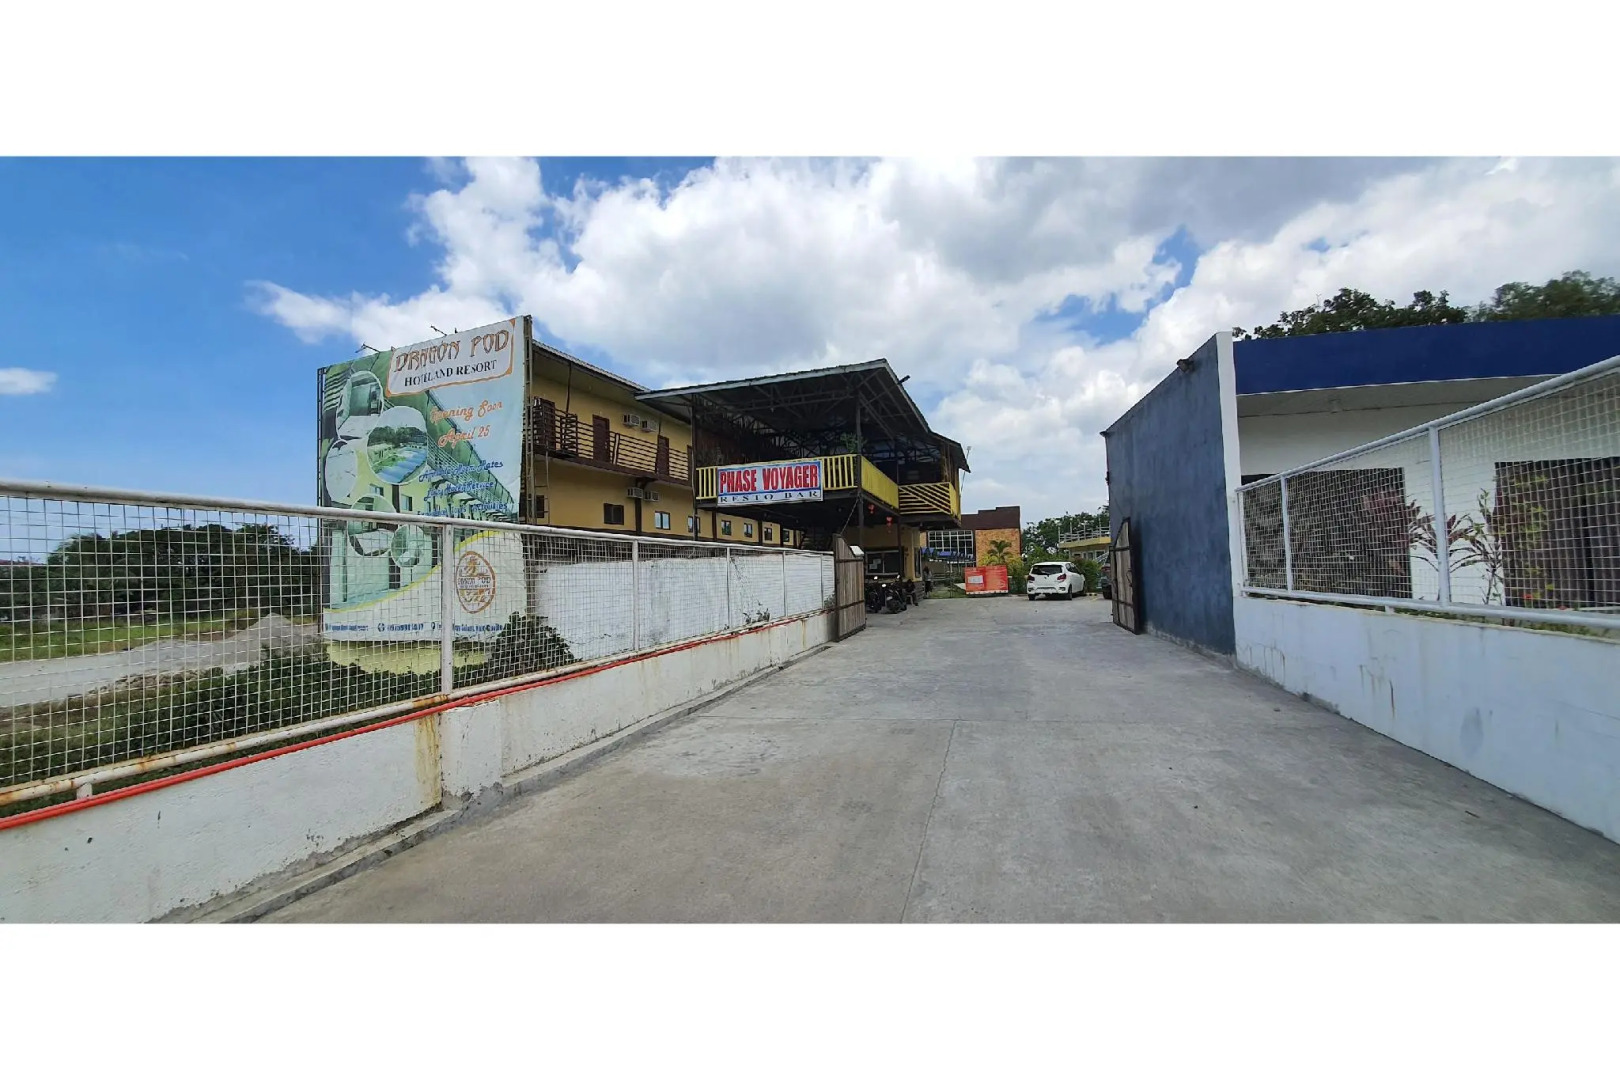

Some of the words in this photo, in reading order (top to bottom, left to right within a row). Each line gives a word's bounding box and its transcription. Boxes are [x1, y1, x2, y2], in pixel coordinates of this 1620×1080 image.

[393, 341, 461, 372] DRAGON
[470, 330, 509, 357] POD
[456, 359, 497, 375] RESORT
[430, 406, 474, 424] Opening
[478, 400, 503, 417] Soon
[438, 426, 476, 448] April
[477, 425, 491, 438] 25
[477, 459, 504, 473] Rates
[720, 469, 757, 493] PHASE
[762, 464, 818, 491] VOYAGER
[720, 493, 774, 503] RESTO
[784, 491, 818, 499] BAR
